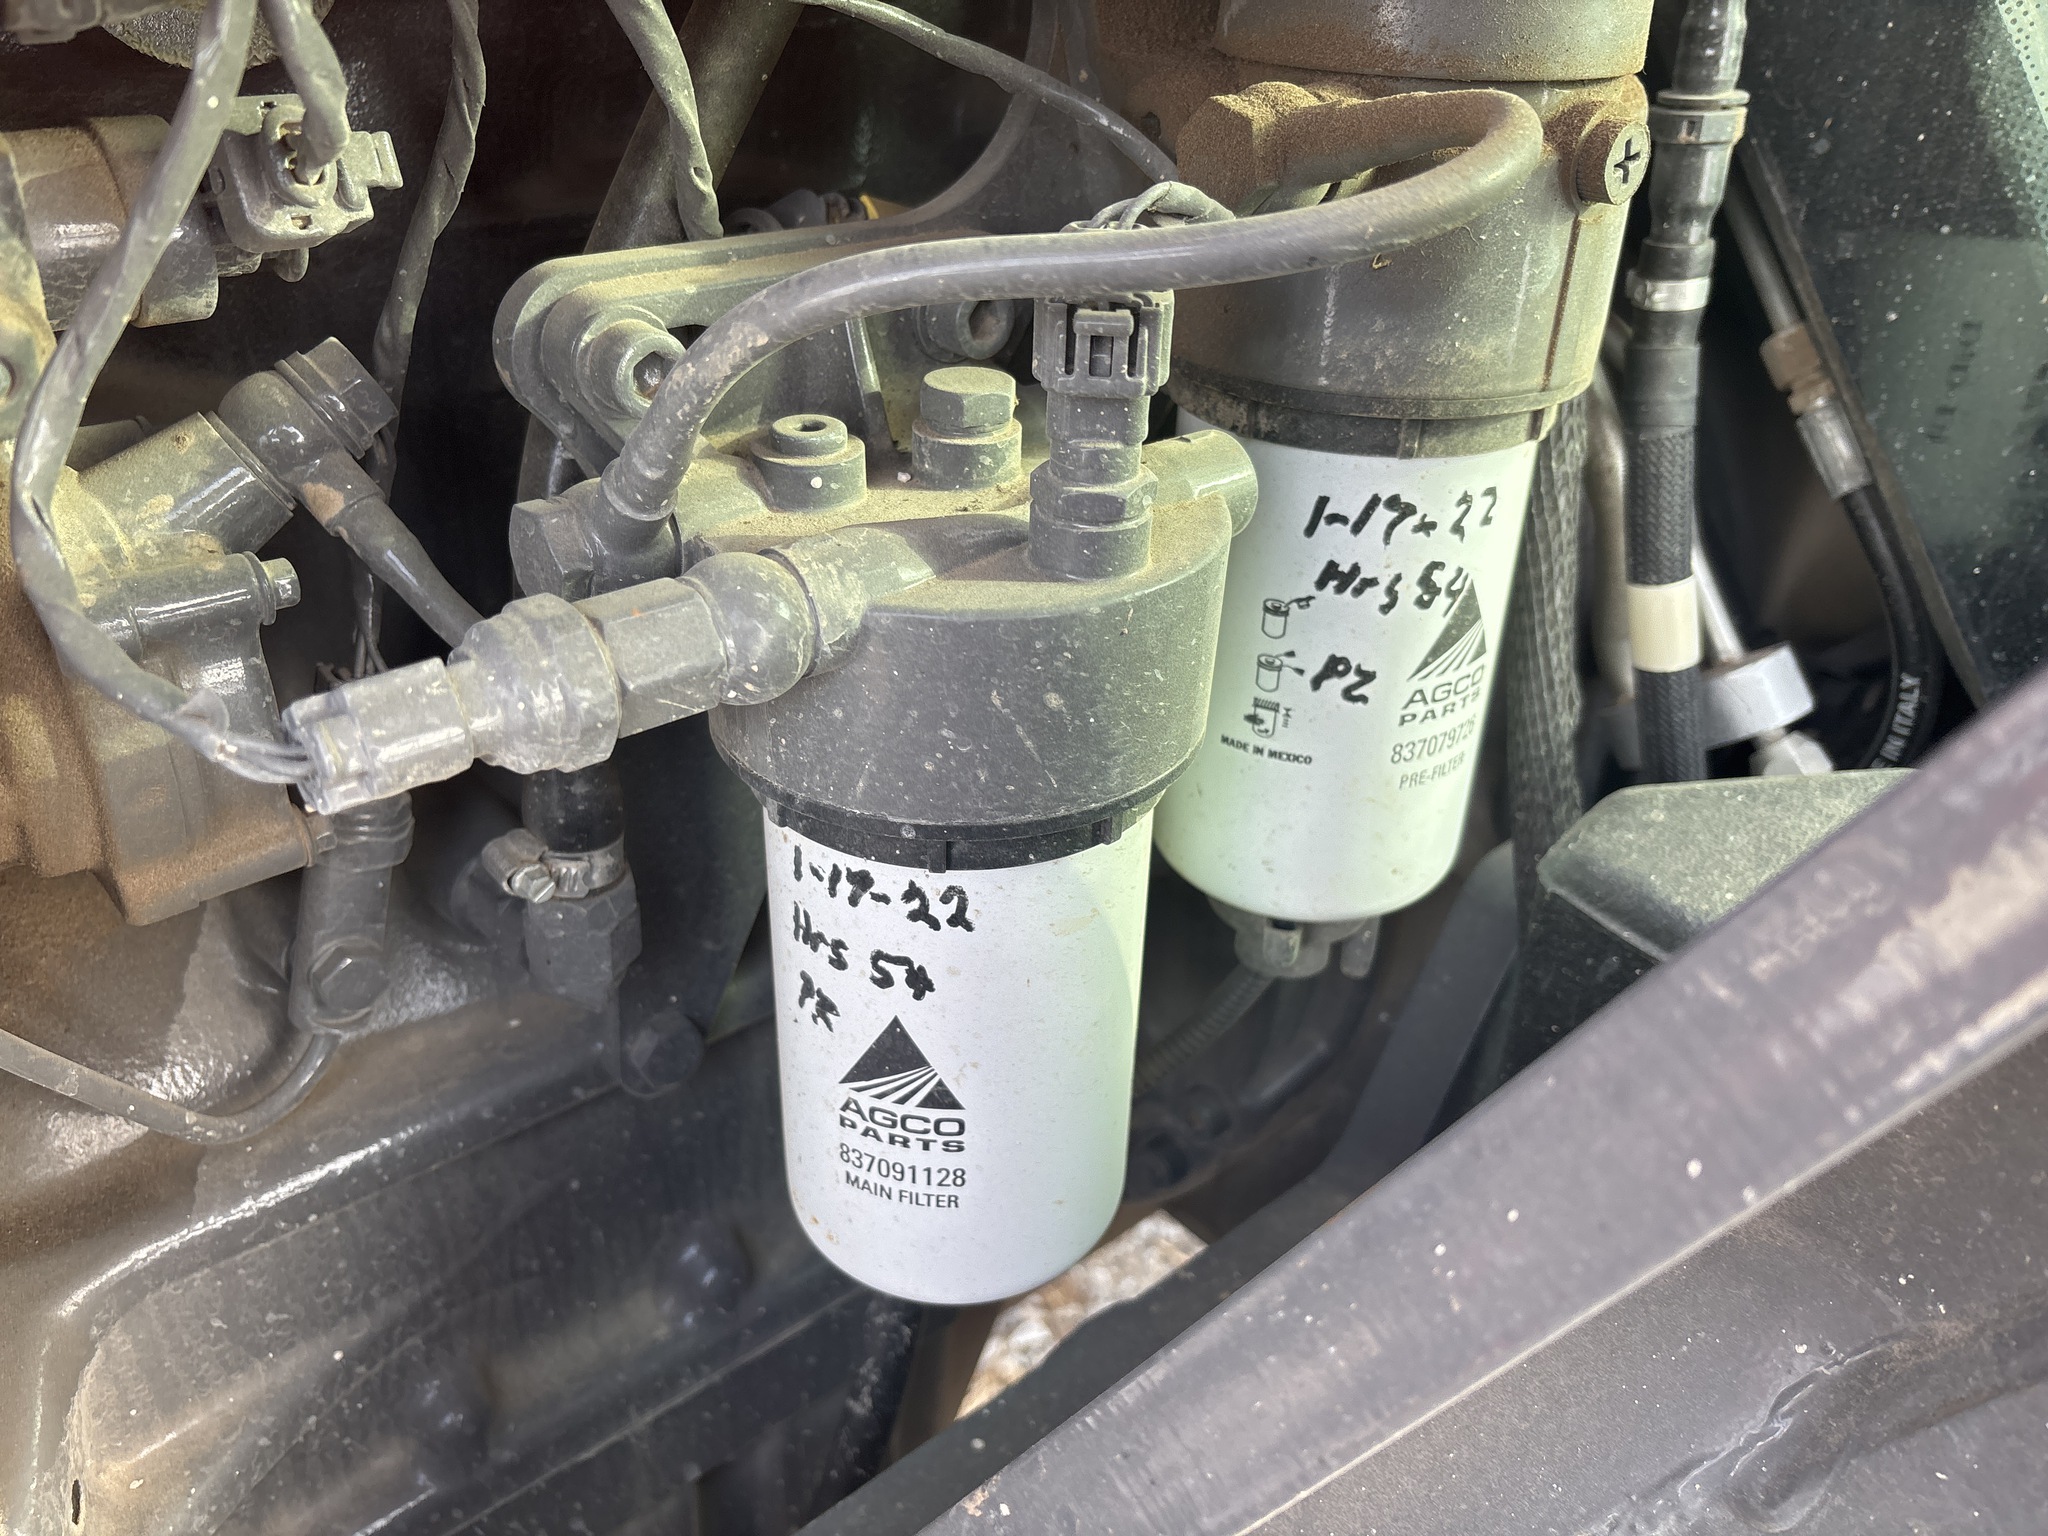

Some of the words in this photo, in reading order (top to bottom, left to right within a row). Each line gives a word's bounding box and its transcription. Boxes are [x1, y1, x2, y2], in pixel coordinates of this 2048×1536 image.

[1398, 686, 1481, 727] PARTS
[1401, 664, 1485, 711] AGCO
[1891, 672, 1921, 737] ITALY
[1220, 733, 1250, 753] MADE
[1252, 744, 1264, 756] IN
[1267, 748, 1313, 765] MEXICO
[1398, 751, 1465, 790] PRE-FILTER
[839, 1096, 966, 1136] AGCO
[839, 1113, 965, 1152] PARTS
[839, 1142, 966, 1187] 837091128
[845, 1170, 893, 1201] MAIN
[898, 1189, 960, 1208] FILTER
